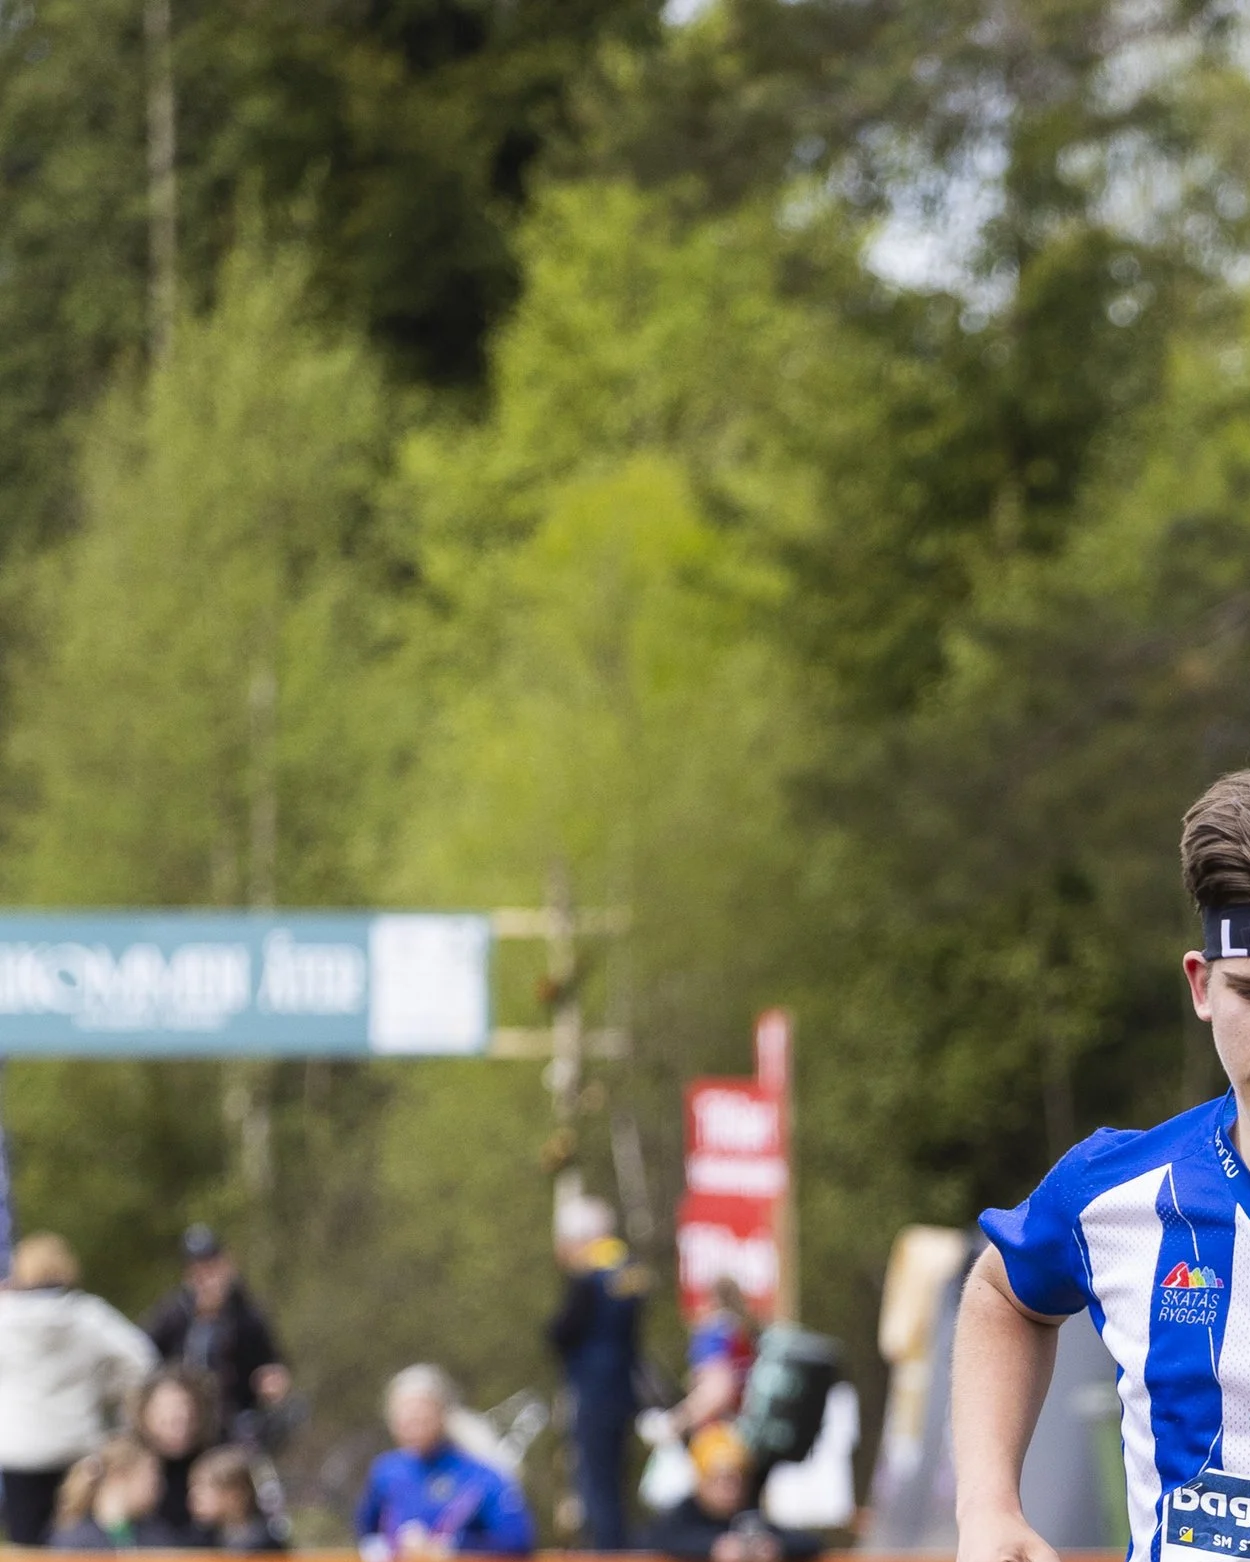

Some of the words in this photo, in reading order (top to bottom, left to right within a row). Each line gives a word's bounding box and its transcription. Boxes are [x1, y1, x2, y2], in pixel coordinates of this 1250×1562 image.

[1161, 1288, 1221, 1310] SKATÅS
[1158, 1306, 1218, 1327] RYGGAR
[1212, 1534, 1233, 1549] SM
